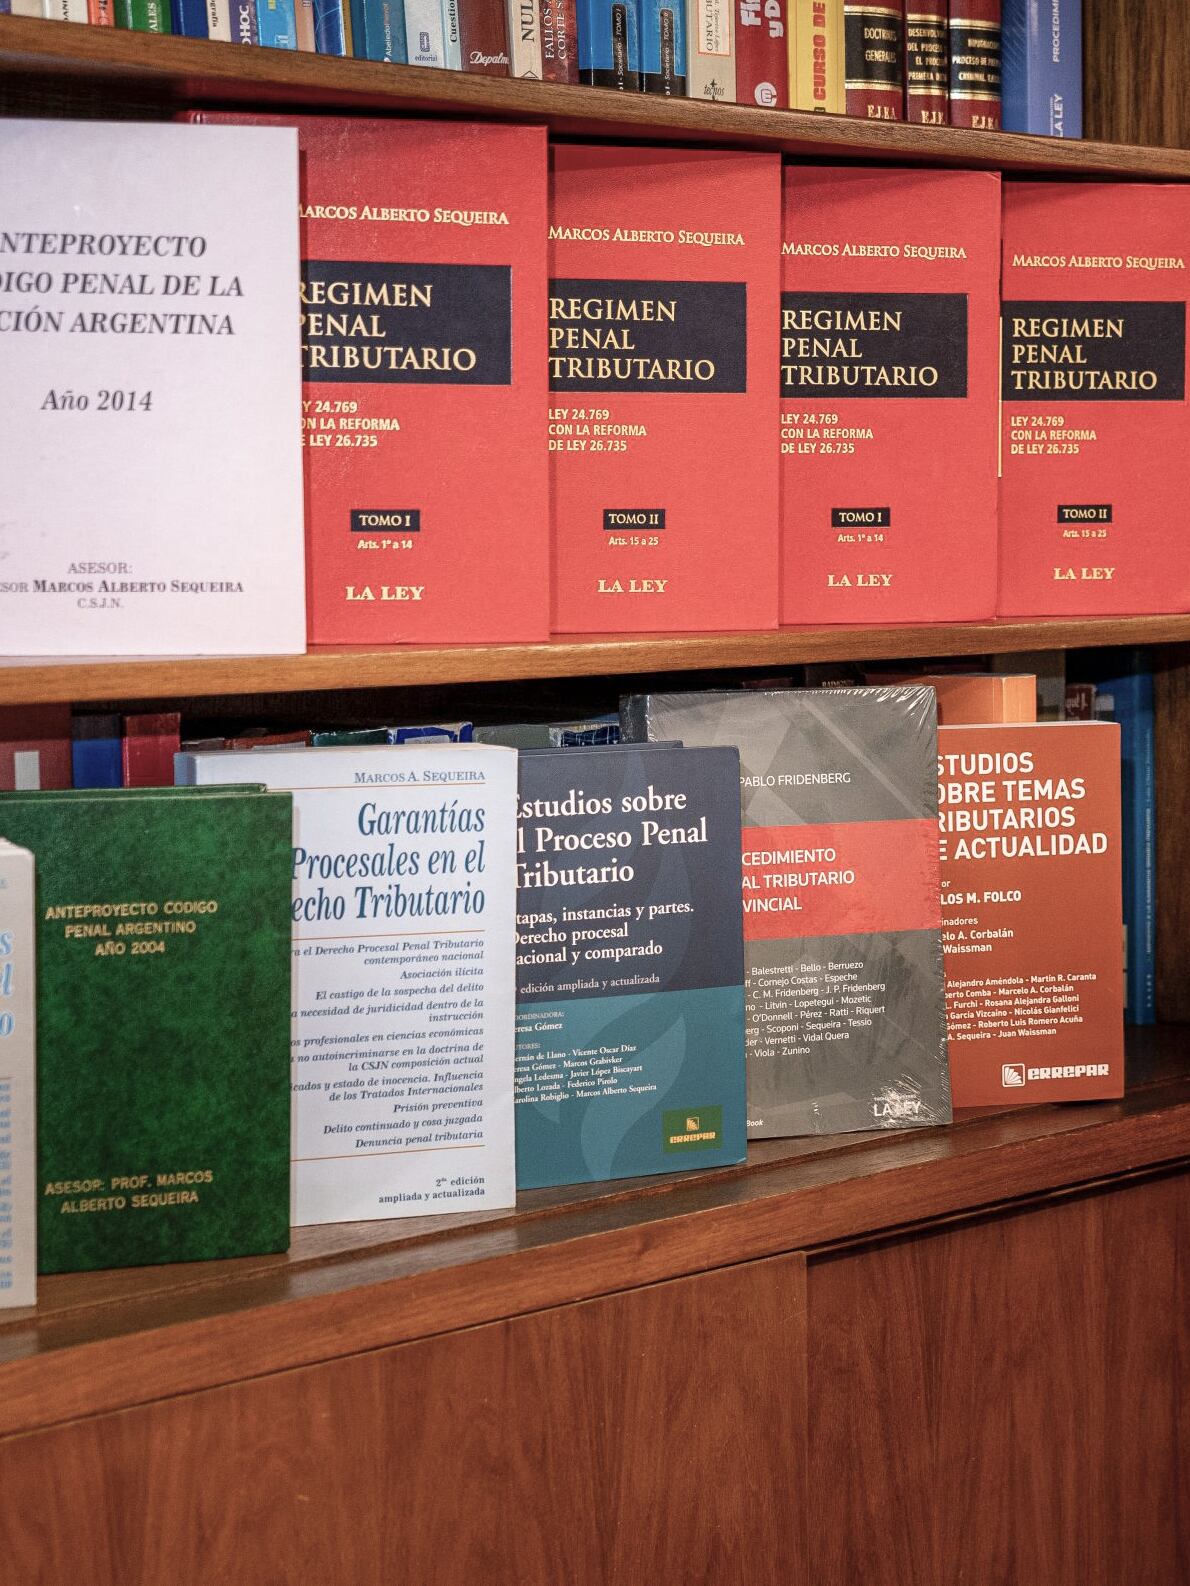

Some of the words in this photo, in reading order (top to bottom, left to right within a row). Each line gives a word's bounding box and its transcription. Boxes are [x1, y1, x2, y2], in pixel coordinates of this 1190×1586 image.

[148, 2, 160, 32] ALES
[448, 0, 457, 42] Cuestio
[521, 0, 534, 43] NUL
[813, 1, 825, 28] DE
[543, 8, 554, 59] FALLOS
[557, 13, 566, 59] CORTE
[415, 54, 437, 62] editorial
[470, 51, 509, 66] Depalm
[616, 42, 624, 76] Societario
[813, 34, 826, 100] CURSO
[1054, 94, 1063, 118] LEY
[360, 206, 429, 222] ALBERTO
[433, 209, 510, 226] SEQUEIRA
[0, 232, 207, 257] NTEPROYECTO
[548, 226, 610, 240] MARCOS
[612, 228, 674, 243] ALBERTO
[678, 230, 745, 246] SEQUEIRA
[781, 242, 839, 255] MARCOS
[842, 244, 899, 257] ALBERTO
[904, 245, 967, 260] SEQUEIRA
[1013, 255, 1066, 268] MARCOS
[1068, 256, 1122, 268] ALBERTO
[1126, 257, 1185, 270] SEQUEIRA
[0, 272, 53, 294] IGO
[60, 273, 154, 295] PENAL
[162, 274, 201, 296] DE
[208, 276, 244, 297] LA
[549, 298, 677, 322] REGIMEN
[0, 306, 64, 332] CIÓN
[69, 311, 236, 335] ARGENTINA
[782, 310, 902, 331] REGIMEN
[1012, 318, 1124, 338] REGIMEN
[549, 328, 635, 350] PENAL
[782, 338, 863, 357] PENAL
[1012, 345, 1087, 364] PENAL
[549, 357, 715, 381] TRIBUTARIO
[781, 366, 939, 386] TRIBUTARIO
[1011, 371, 1157, 390] TRIBUTARIO
[41, 389, 89, 410] Año
[96, 390, 153, 411] 2014
[548, 409, 569, 420] LEY
[572, 409, 610, 420] 24.769
[1011, 416, 1028, 426] LEY
[1031, 417, 1064, 426] 24.769
[548, 424, 573, 435] CON
[576, 425, 590, 435] LA
[593, 425, 647, 436] REFORMA
[548, 440, 563, 450] DE
[567, 440, 587, 451] LEY
[590, 440, 627, 451] 26.735
[359, 515, 401, 526] TOMO
[609, 513, 647, 524] TOMO
[649, 514, 659, 525] II
[608, 537, 628, 545] Arts.
[630, 537, 639, 545] 15
[649, 537, 659, 545] 25
[68, 562, 132, 574] ASESOR:
[1054, 568, 1076, 579] LA
[1082, 568, 1115, 579] LEY
[32, 580, 93, 592] MARCOS
[98, 580, 166, 592] ALBERTO
[170, 580, 244, 596] SEQUEIRA
[598, 580, 624, 593] LA
[629, 580, 668, 593] LEY
[828, 574, 852, 586] LA
[857, 575, 893, 586] LEY
[345, 586, 375, 600] LA
[381, 586, 424, 601] LEY
[77, 598, 124, 609] C.S.J.N.
[938, 752, 1033, 776] TUDIOS
[354, 772, 405, 784] MARCOS
[423, 771, 485, 783] SEQUEIRA
[778, 773, 851, 785] FRIDENBERG
[621, 785, 686, 813] sobre
[1003, 778, 1085, 802] TEMAS
[358, 800, 485, 836] Garantías
[938, 806, 1075, 832] IBUTARIOS
[535, 827, 632, 853] Proceso
[642, 817, 708, 846] Penal
[954, 833, 1108, 860] ACTUALIDAD
[428, 849, 457, 875] en
[465, 840, 485, 874] el
[742, 848, 836, 866] CEDIMIENTO
[763, 871, 854, 888] TRIBUTARIO
[292, 888, 345, 921] echo
[355, 881, 485, 919] Tributario
[742, 897, 802, 912] VINCIAL
[966, 893, 980, 903] M.
[984, 890, 1021, 902] FOLCO
[45, 903, 158, 920] ANTEPROYECTO
[164, 901, 218, 915] CODIGO
[64, 924, 111, 938] PENAL
[116, 921, 196, 936] ARGENTINO
[970, 928, 1013, 939] Corbalán
[94, 941, 125, 956] AÑO
[131, 941, 165, 955] 2004
[516, 947, 567, 965] acional
[572, 952, 581, 965] y
[585, 941, 663, 962] comparado
[943, 944, 992, 953] Waissman
[400, 969, 451, 980] Asociación
[454, 967, 484, 977] ilícita
[1067, 973, 1096, 981] Caranta
[755, 1049, 775, 1057] Viola
[782, 1047, 810, 1056] Zunino
[576, 1088, 601, 1098] Marcos
[602, 1086, 627, 1096] Alberto
[629, 1084, 657, 1094] Sequeira
[111, 1177, 152, 1190] PROF.
[157, 1170, 213, 1186] MARCOS
[451, 1176, 484, 1186] edición
[60, 1196, 126, 1214] ALBERTO
[131, 1191, 199, 1209] SEQUEIRA
[378, 1192, 422, 1204] ampliada
[424, 1193, 430, 1202] y
[433, 1187, 485, 1200] actualizada
